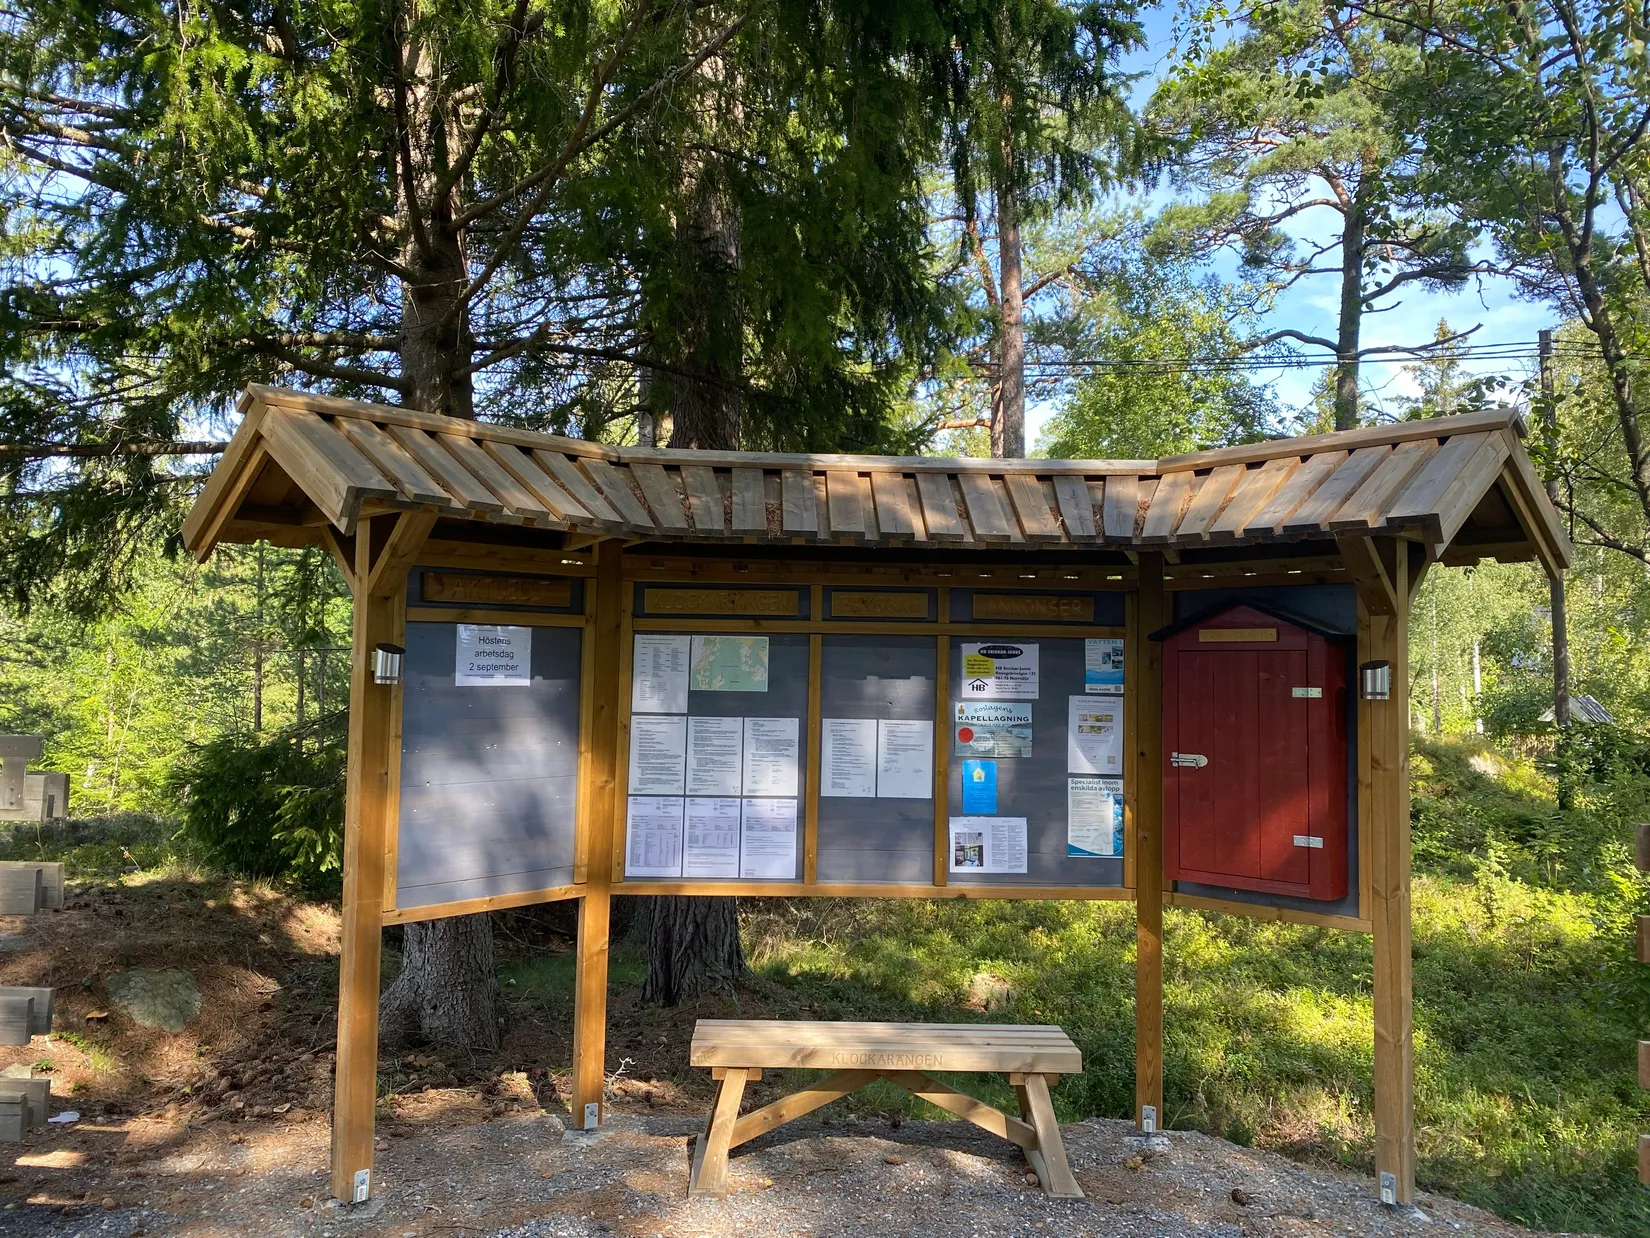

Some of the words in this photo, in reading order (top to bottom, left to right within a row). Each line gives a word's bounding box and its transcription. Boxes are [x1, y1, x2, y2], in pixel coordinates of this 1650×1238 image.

[451, 578, 551, 601] AKTUELLT
[984, 598, 1083, 617] ANNONSER
[478, 635, 511, 645] Höstens
[474, 649, 514, 660] arbetsdag
[469, 662, 475, 671] 2
[476, 662, 519, 674] september
[973, 704, 1013, 714] Roslagens
[832, 1052, 943, 1067] KLOCKARÄNGEN
